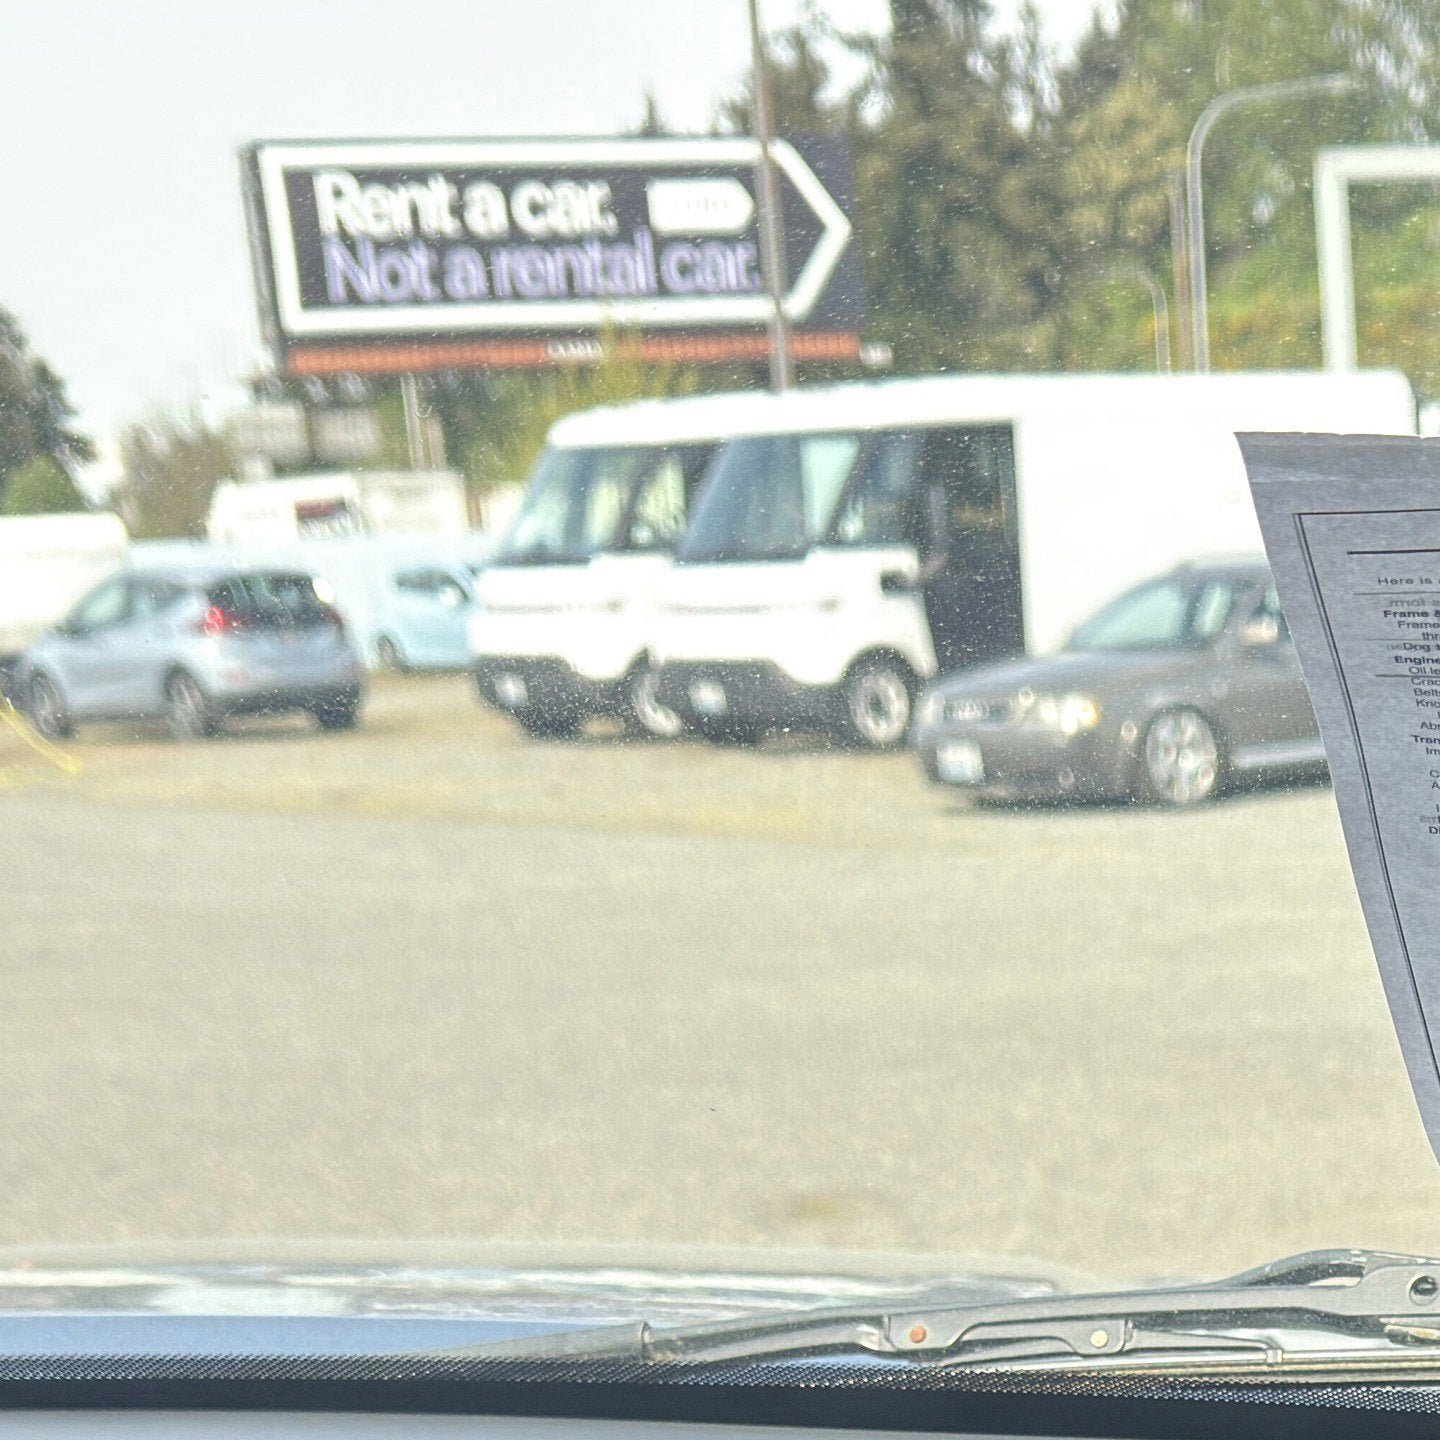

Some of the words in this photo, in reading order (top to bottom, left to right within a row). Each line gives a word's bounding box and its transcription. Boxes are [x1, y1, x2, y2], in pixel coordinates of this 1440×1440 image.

[312, 171, 459, 238] Rent
[463, 181, 508, 236] a
[510, 177, 617, 239] car.
[324, 233, 440, 302] Not
[446, 244, 488, 299] a
[491, 225, 657, 299] rental
[663, 240, 761, 296] car.
[1378, 576, 1414, 586] Here
[1383, 610, 1429, 618] Frame
